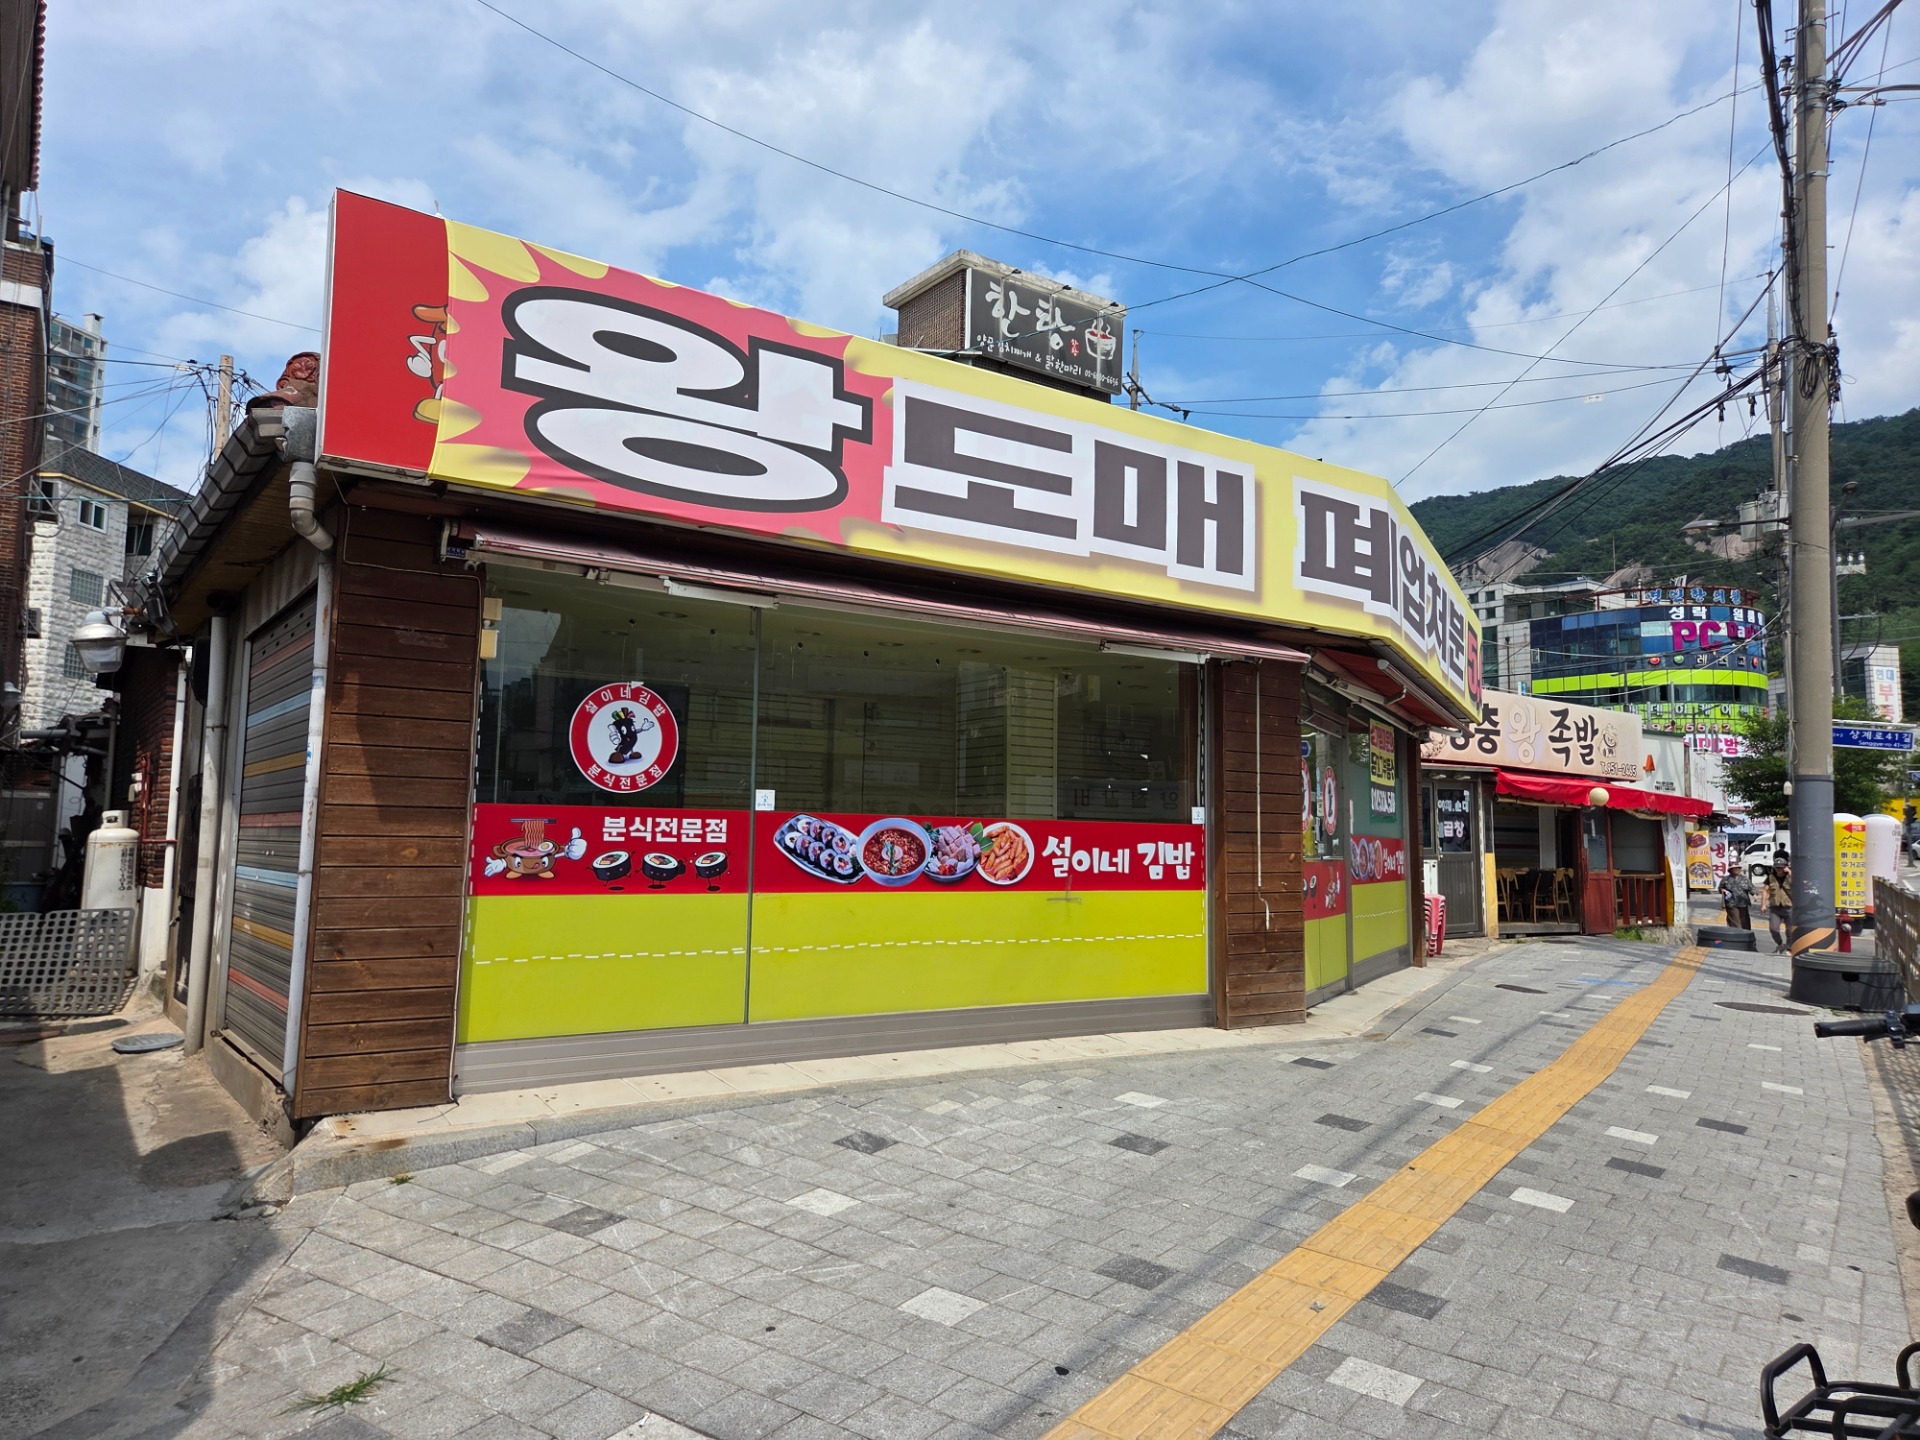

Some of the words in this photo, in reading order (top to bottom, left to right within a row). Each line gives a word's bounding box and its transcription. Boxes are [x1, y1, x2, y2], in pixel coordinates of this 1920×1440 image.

[1671, 620, 1722, 652] PC
[585, 685, 667, 718] 설이네김밥
[1849, 730, 1912, 743] 상계로41길
[588, 763, 664, 791] 분식전문점
[602, 816, 728, 843] 분식전문점
[1042, 835, 1130, 878] 설이네
[1137, 841, 1195, 880] 김밥
